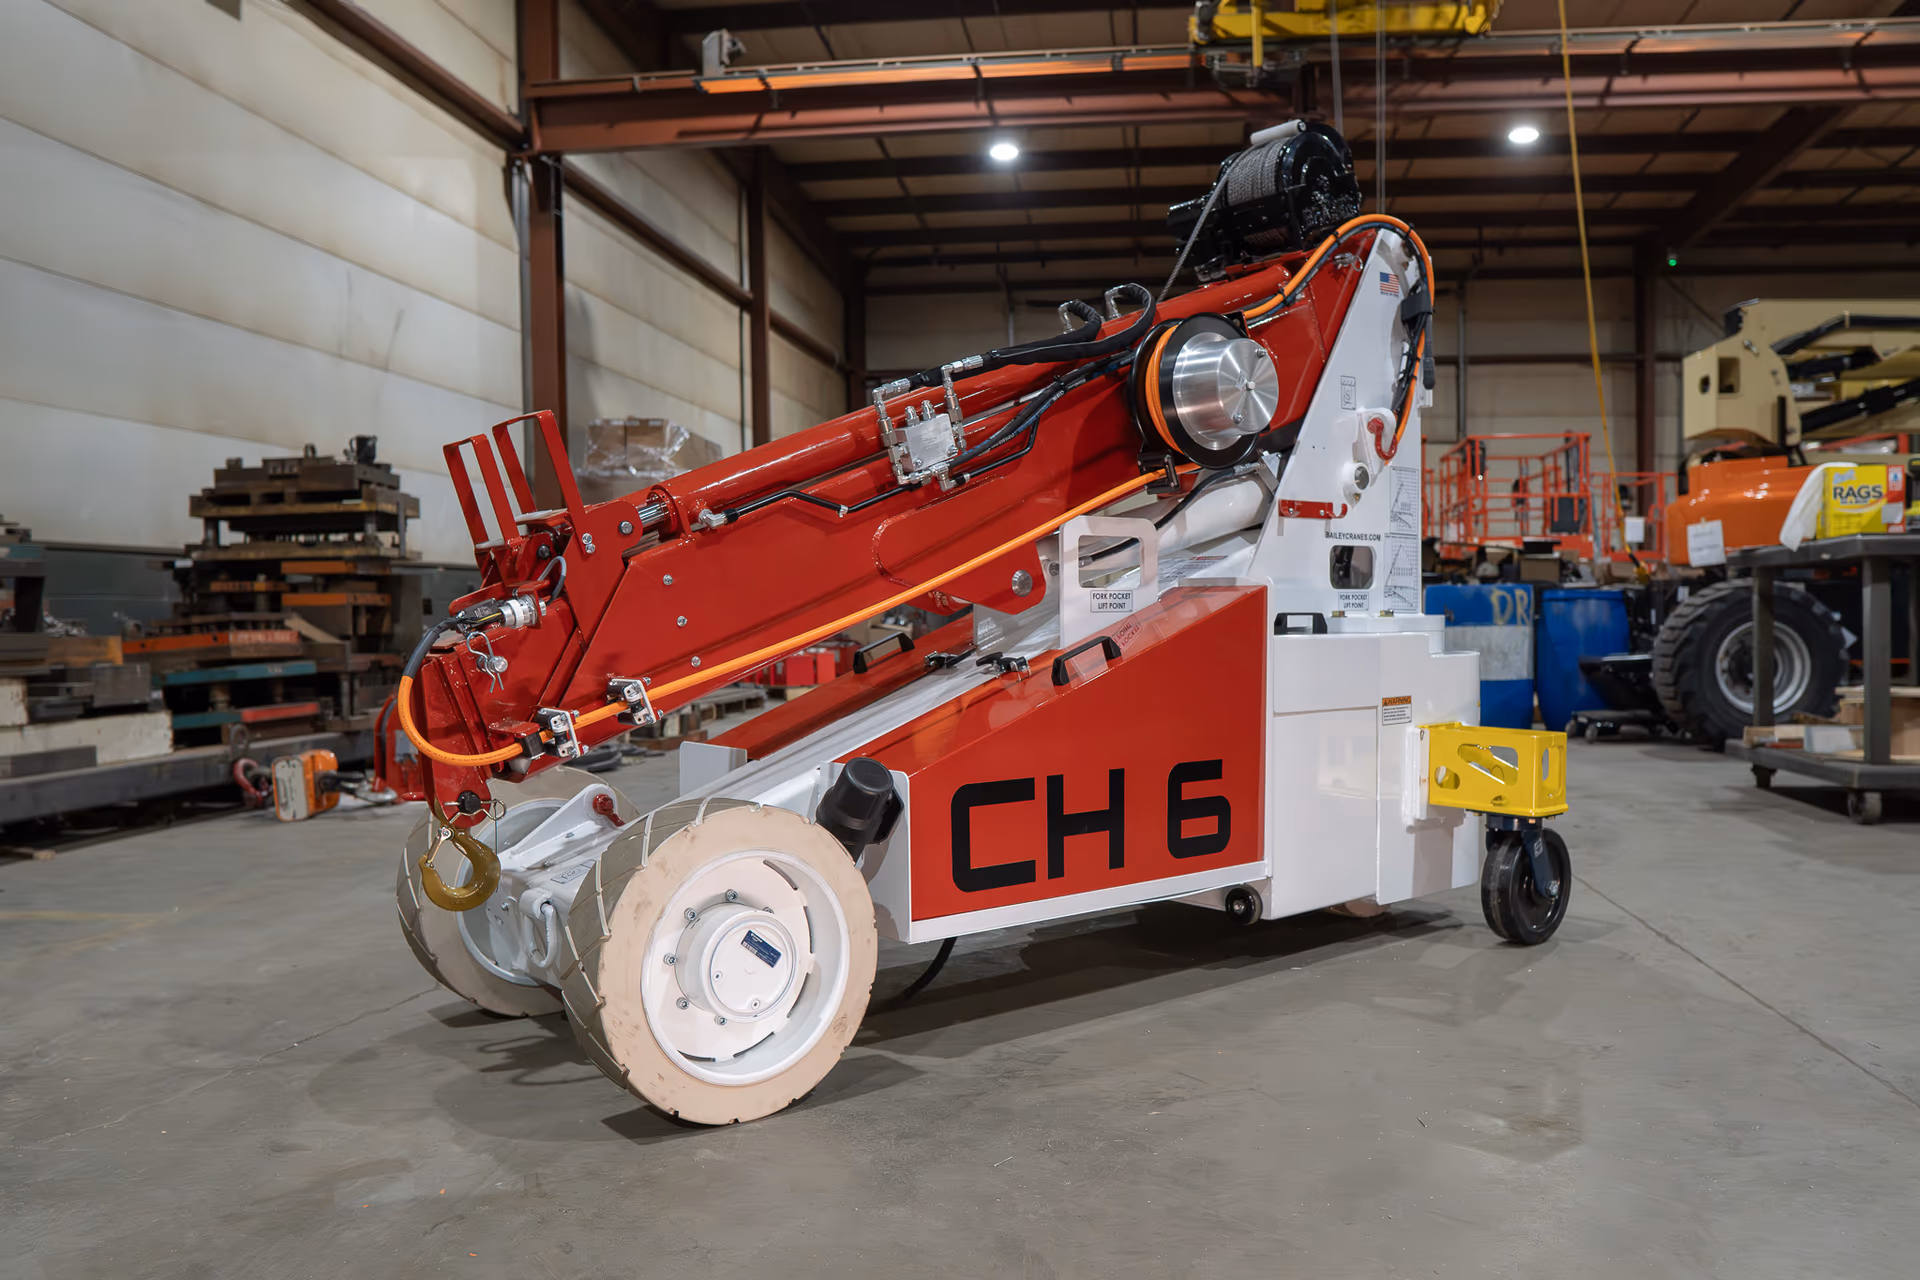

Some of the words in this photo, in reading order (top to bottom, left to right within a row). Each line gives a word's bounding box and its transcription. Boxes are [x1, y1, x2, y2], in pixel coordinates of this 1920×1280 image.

[1832, 485, 1884, 500] RAGS
[1325, 531, 1381, 541] BAILEYCRANES.COM
[1092, 592, 1108, 600] FORK
[1109, 592, 1131, 600] POCKET
[951, 768, 1125, 892] CH
[1167, 759, 1231, 859] 6
